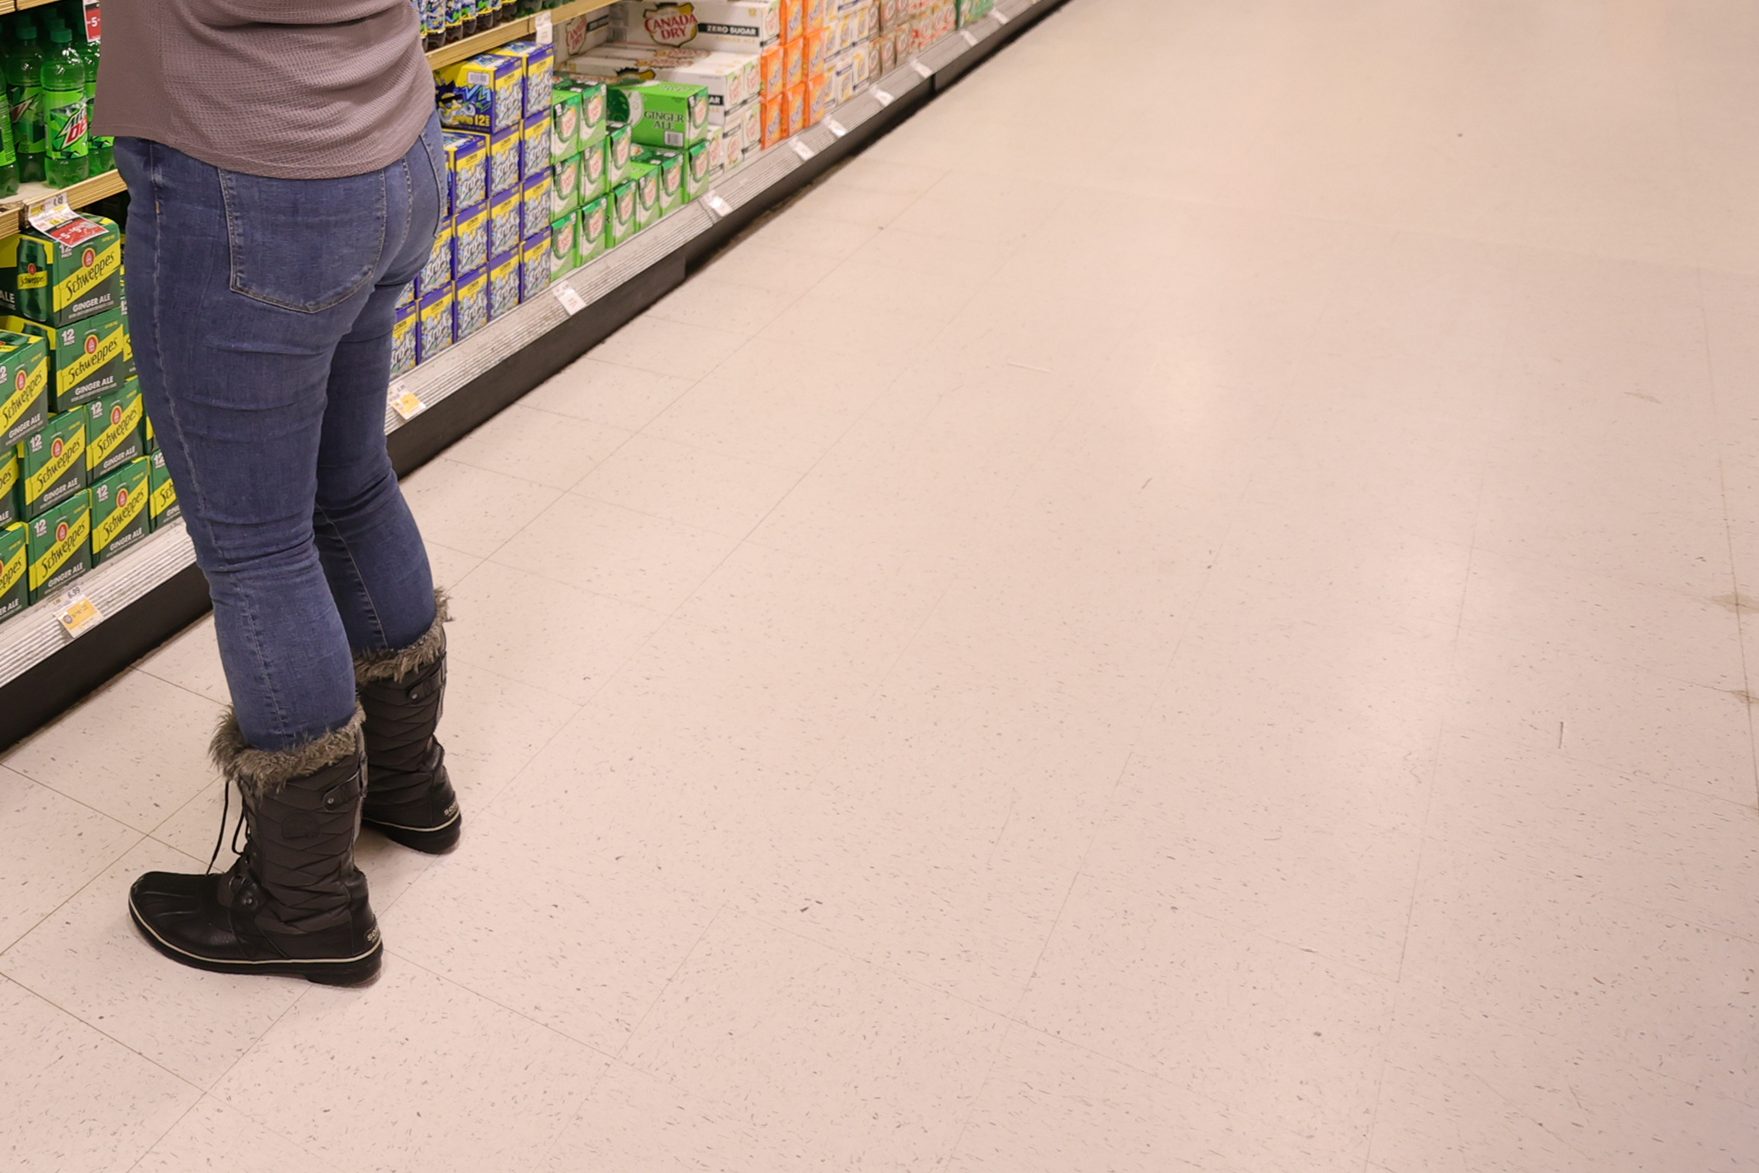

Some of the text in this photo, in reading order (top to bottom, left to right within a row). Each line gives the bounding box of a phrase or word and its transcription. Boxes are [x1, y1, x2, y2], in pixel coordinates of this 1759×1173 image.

[644, 12, 698, 34] CANADA
[706, 24, 757, 36] ZERO SUGAR
[660, 26, 687, 41] DRY
[644, 110, 685, 123] GINGER
[654, 120, 675, 131] ALE
[66, 251, 115, 301] Schweppes
